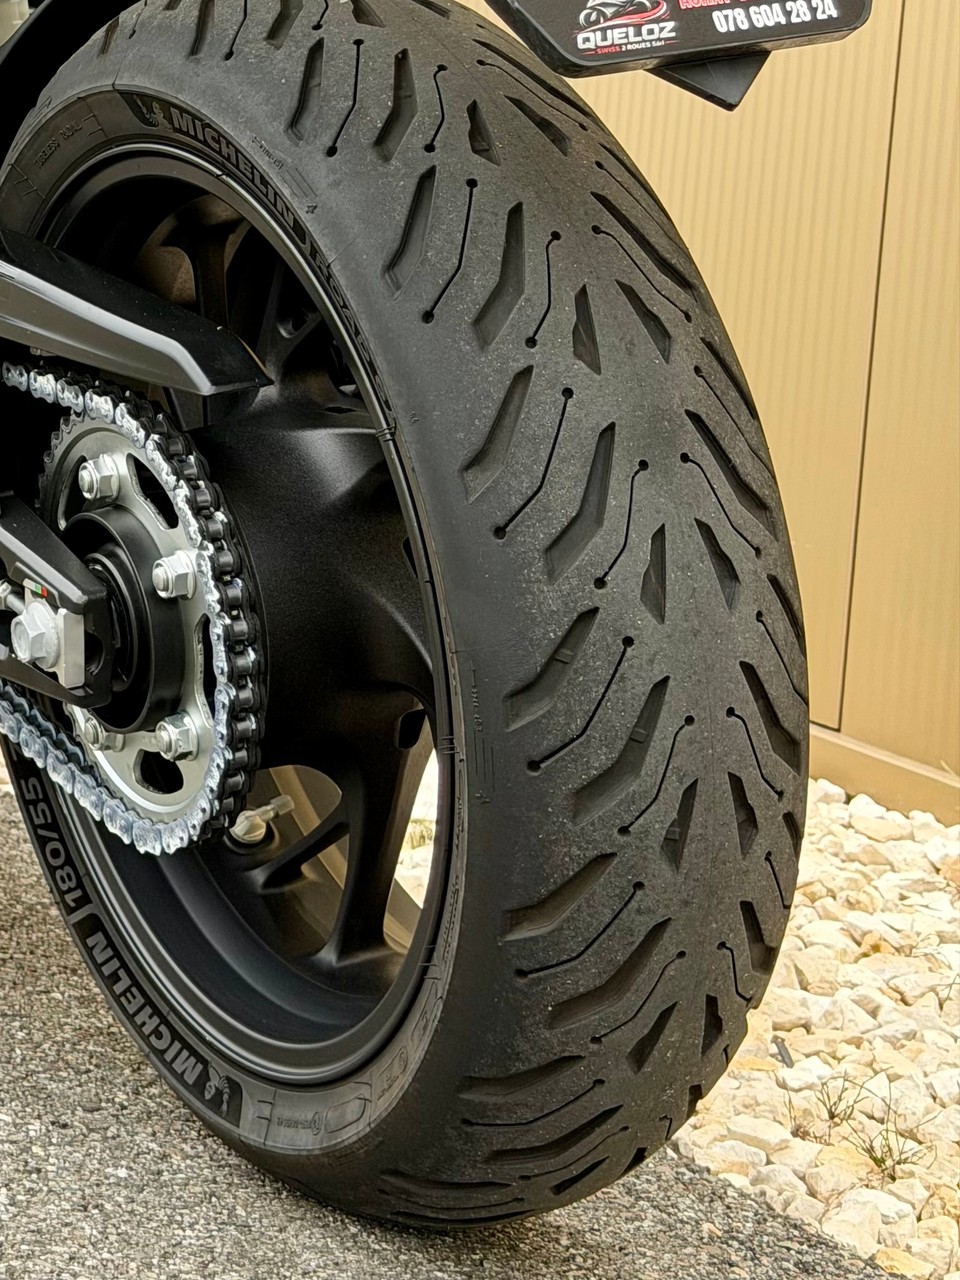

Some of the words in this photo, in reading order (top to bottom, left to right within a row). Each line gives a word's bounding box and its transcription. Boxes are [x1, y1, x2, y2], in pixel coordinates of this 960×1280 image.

[576, 21, 677, 49] QUELOZ
[596, 45, 620, 54] SWISS
[626, 42, 652, 51] ROUES
[712, 9, 749, 33] 078
[749, 3, 786, 28] 604
[785, 0, 812, 24] 28
[170, 107, 295, 229] MICHELIN
[21, 776, 83, 909] 180/55
[86, 930, 204, 1087] MICHELIN
